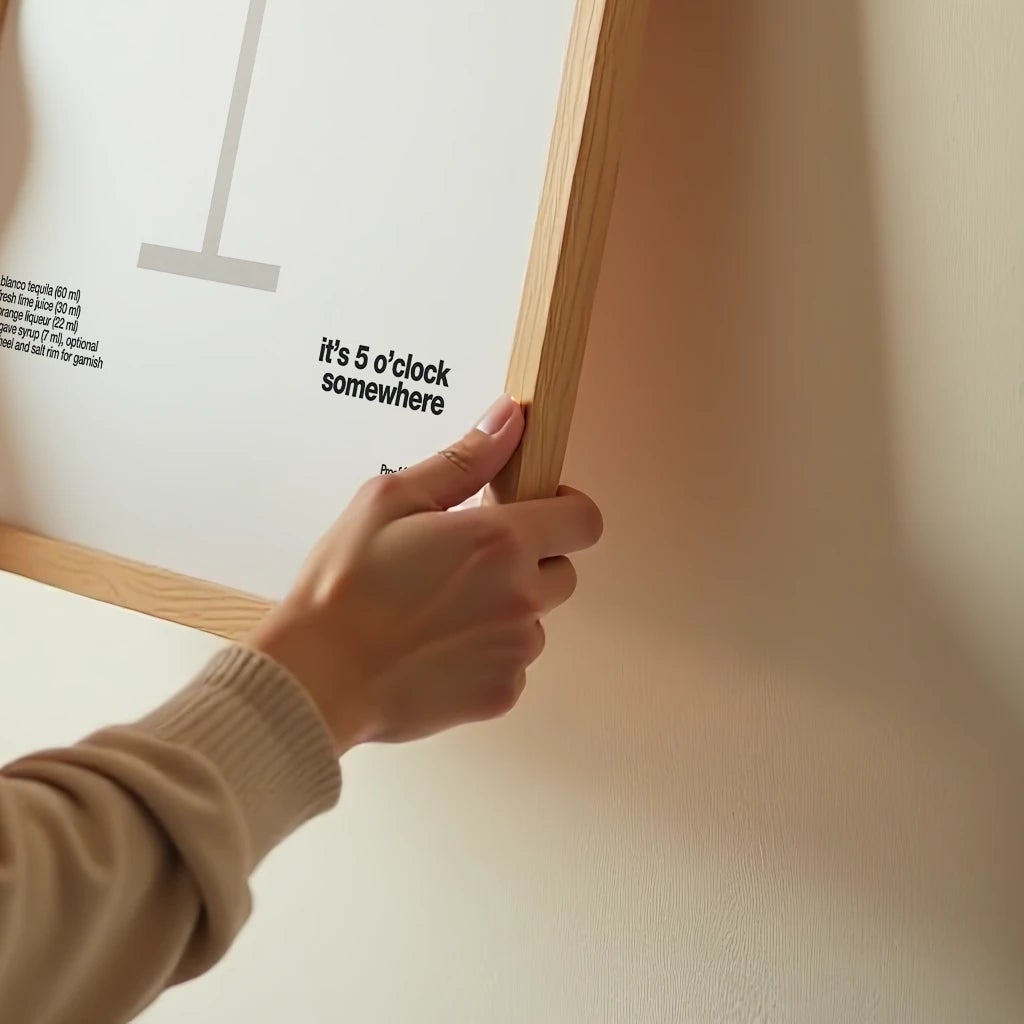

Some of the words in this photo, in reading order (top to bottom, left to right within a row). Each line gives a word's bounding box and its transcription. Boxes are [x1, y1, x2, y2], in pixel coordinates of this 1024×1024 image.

[0, 275, 26, 290] blanco
[28, 280, 54, 296] tequila
[54, 285, 67, 300] (60
[68, 290, 80, 304] ml)
[18, 294, 34, 308] lime
[34, 296, 54, 312] juice
[54, 301, 67, 316] (30
[68, 305, 81, 319] ml)
[24, 310, 52, 326] liqueur
[52, 316, 64, 330] (22
[66, 320, 78, 334] ml)
[18, 326, 40, 342] syrup
[40, 329, 50, 343] (7
[50, 332, 64, 346] ml),
[66, 336, 99, 352] optional
[14, 342, 31, 353] and
[31, 344, 46, 357] salt
[46, 348, 60, 360] rim
[60, 349, 72, 362] for
[74, 354, 104, 370] garnish
[319, 337, 350, 366] it’s
[354, 344, 370, 370] 5
[374, 350, 451, 387] o’clock
[322, 372, 444, 416] somewhere
